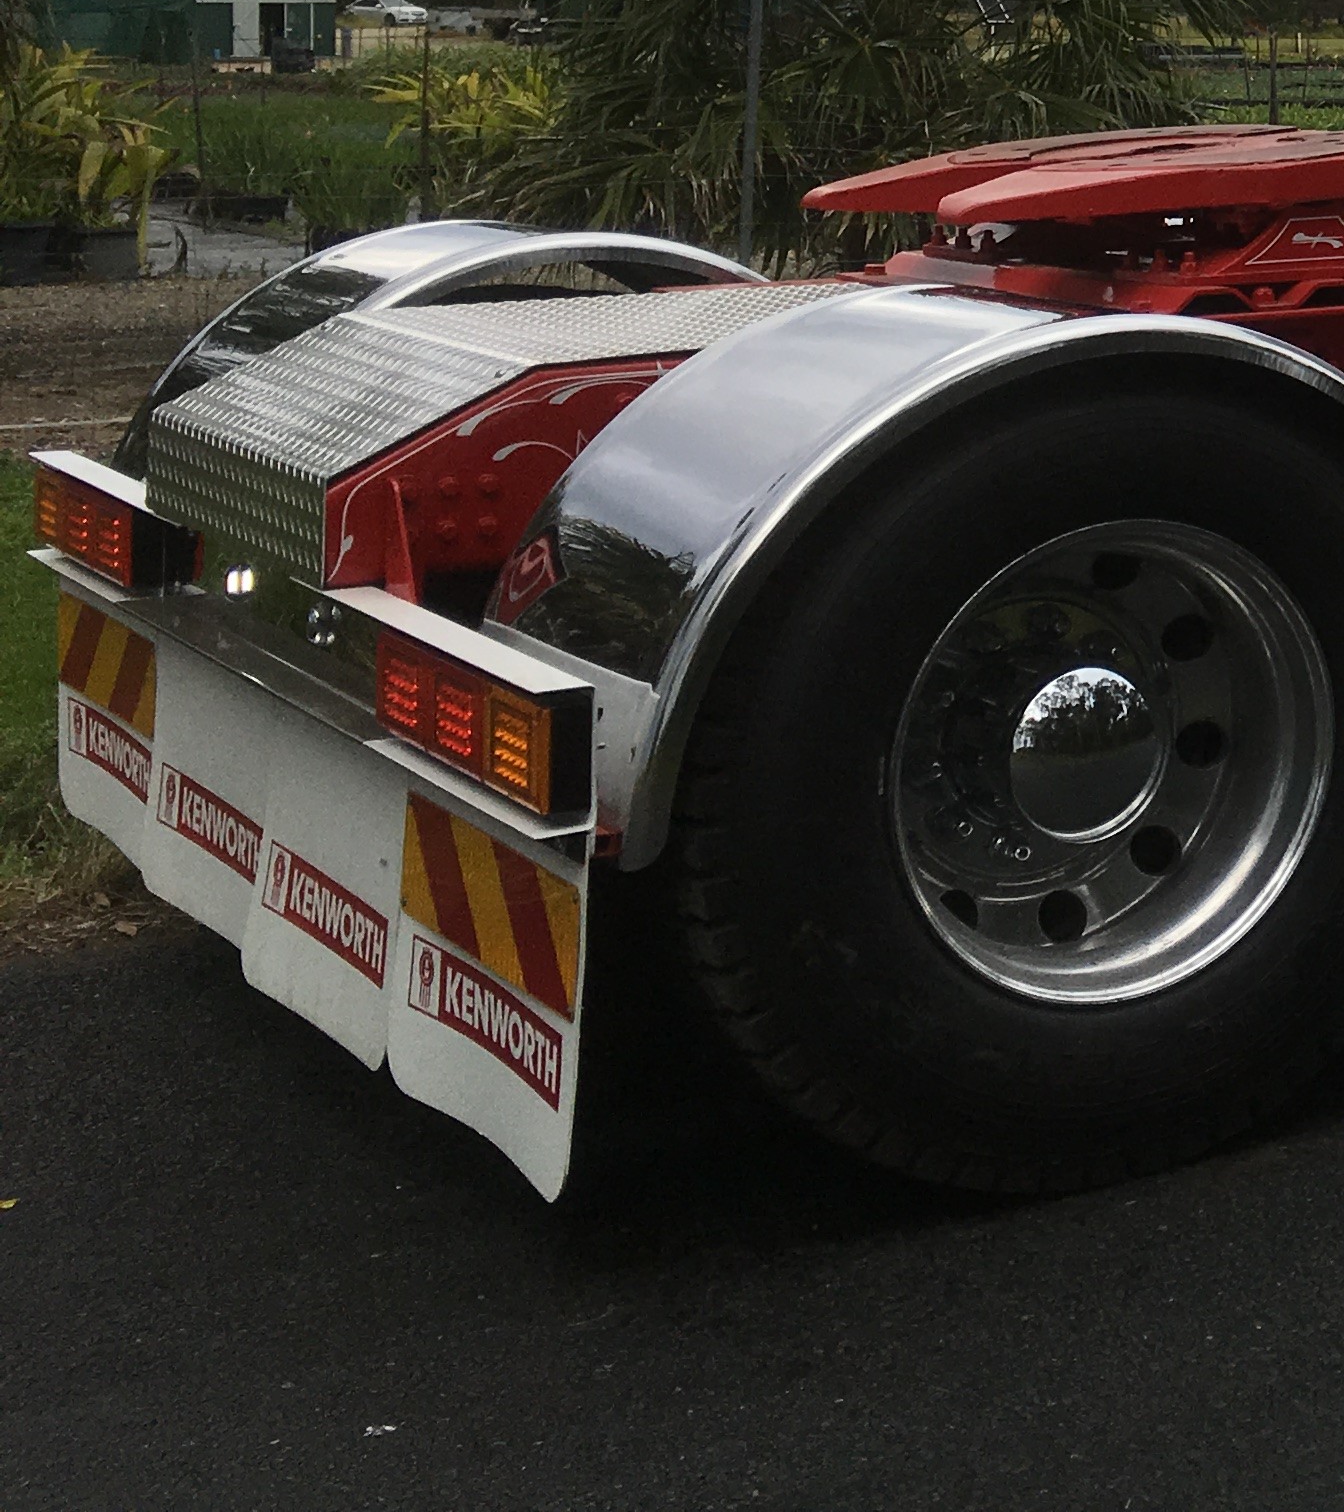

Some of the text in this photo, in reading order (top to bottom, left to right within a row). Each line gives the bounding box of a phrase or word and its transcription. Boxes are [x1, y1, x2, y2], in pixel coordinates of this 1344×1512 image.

[88, 717, 150, 793] KENWORTH
[289, 867, 385, 975] KENWORTH
[444, 965, 558, 1095] KENWORTH
